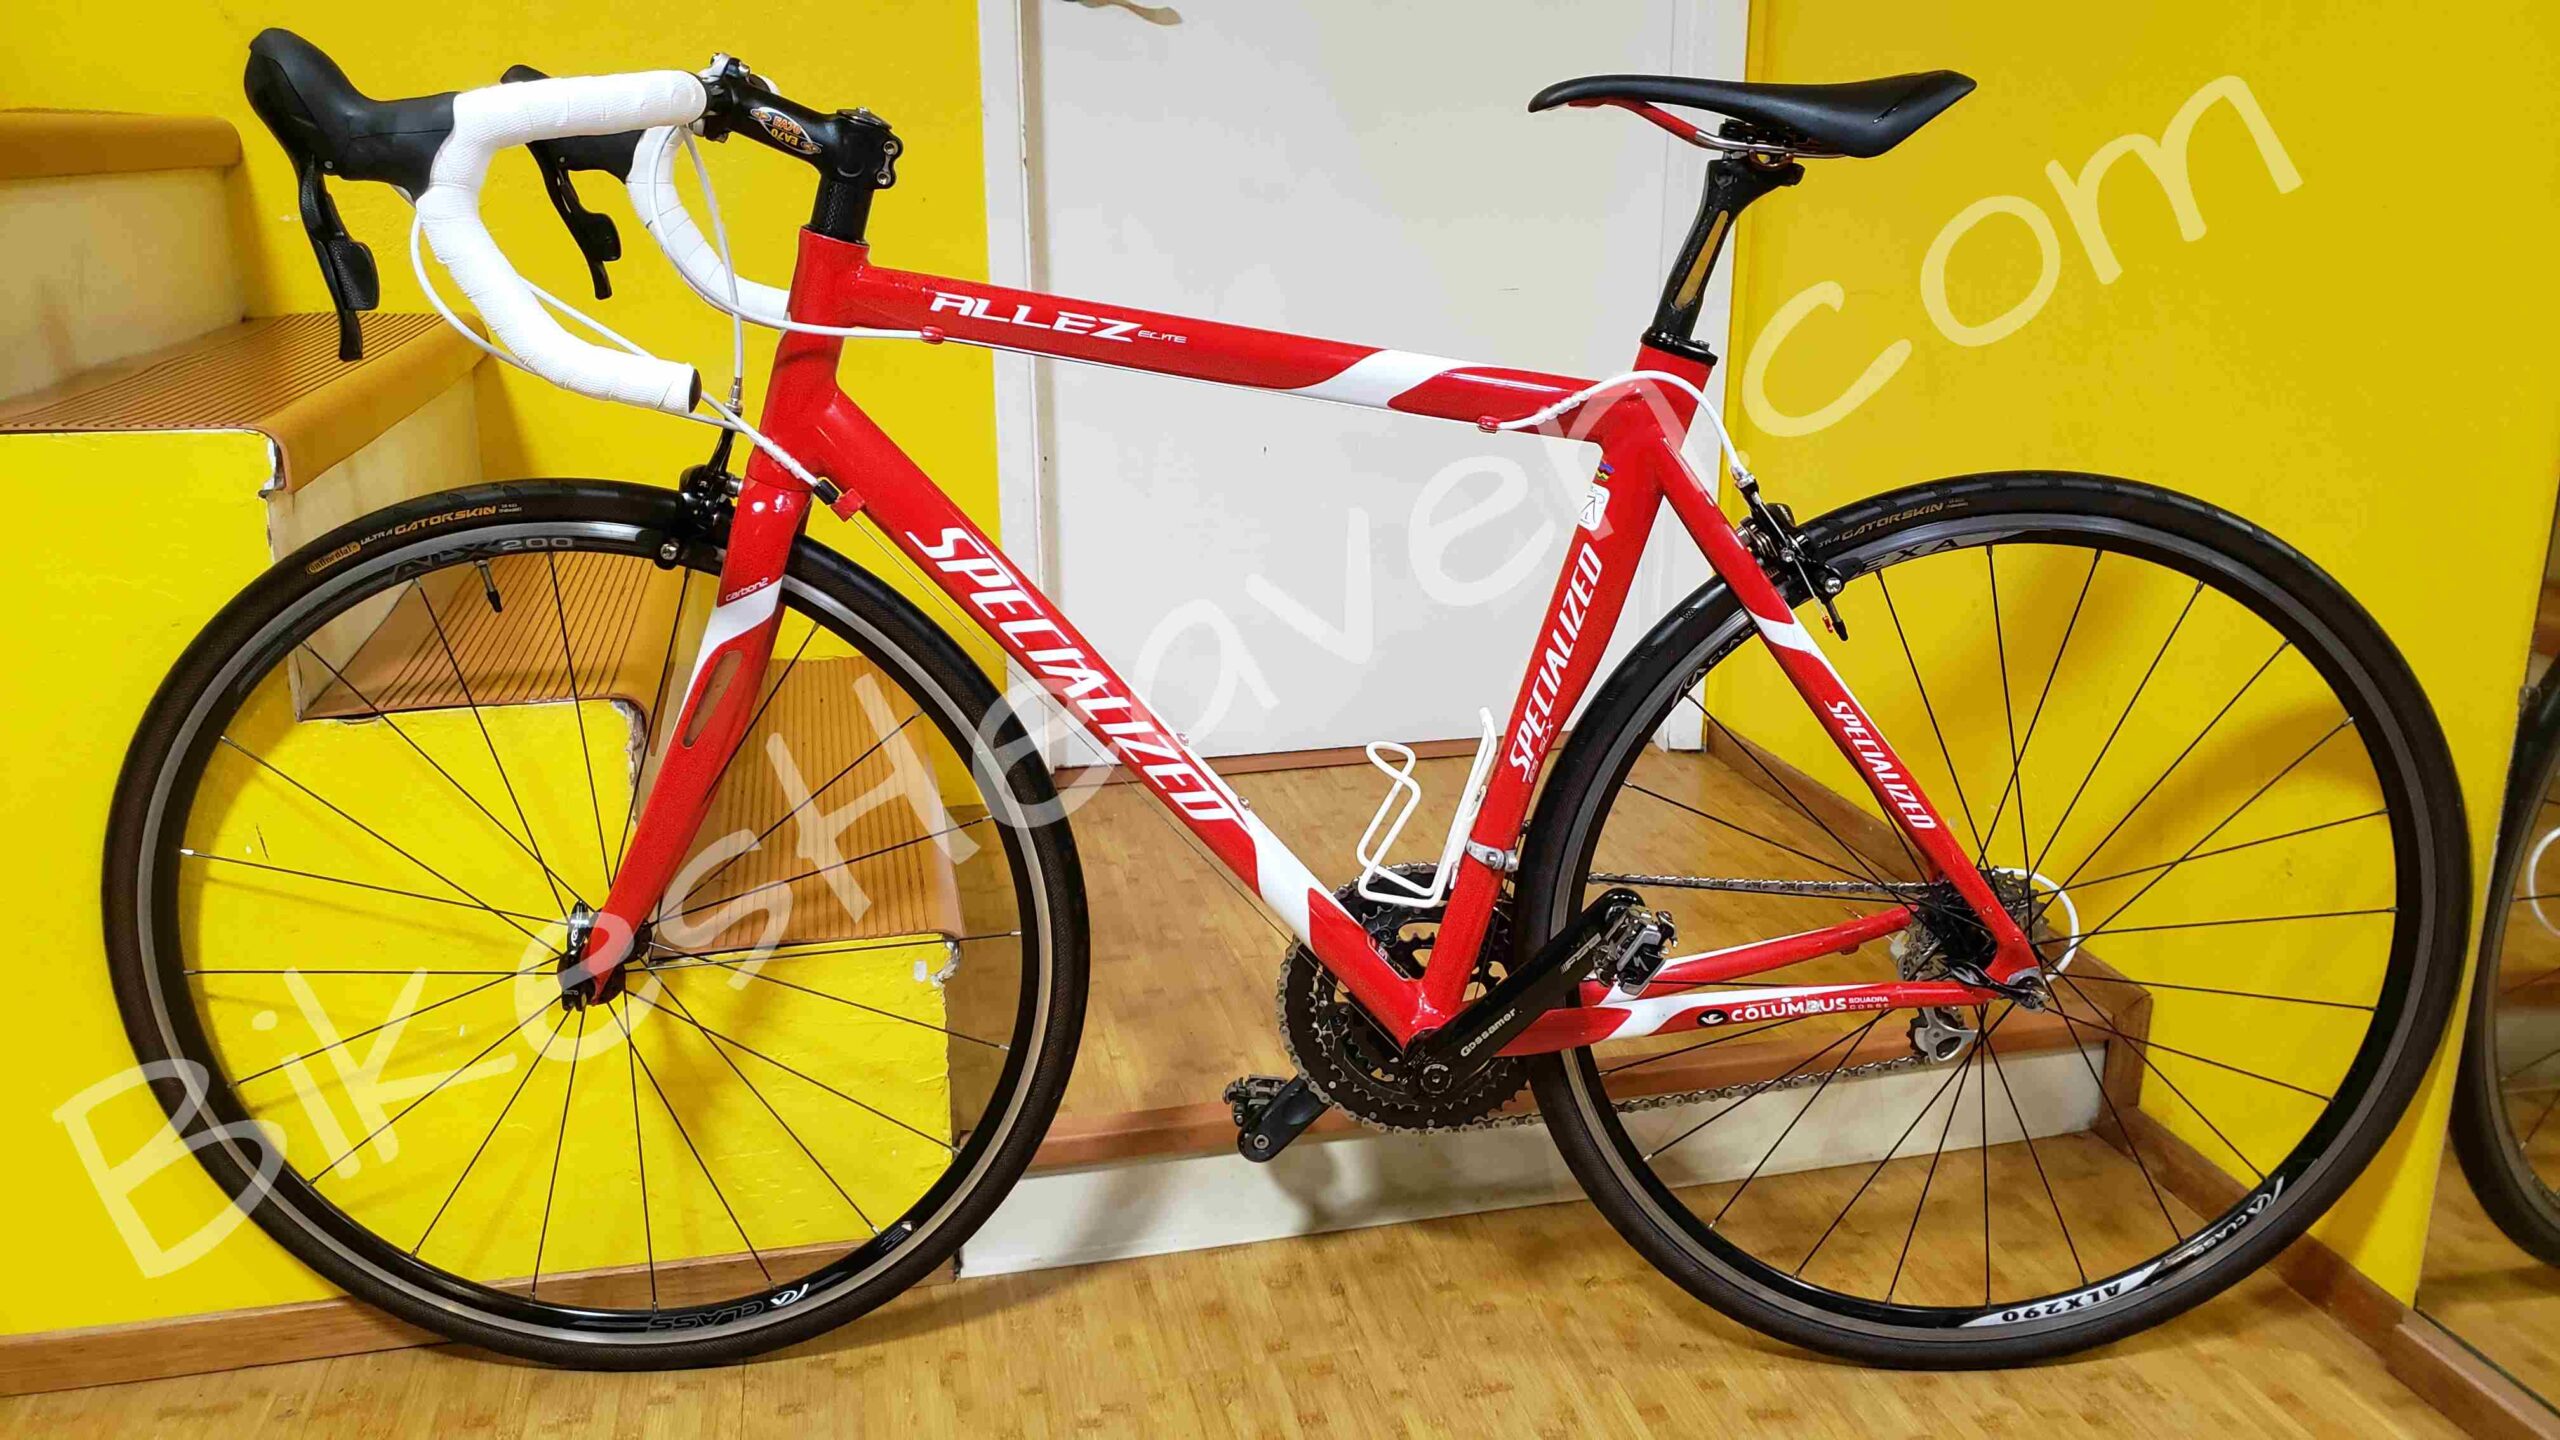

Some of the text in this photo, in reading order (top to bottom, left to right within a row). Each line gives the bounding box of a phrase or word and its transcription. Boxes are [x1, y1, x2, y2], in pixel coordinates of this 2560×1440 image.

[770, 128, 798, 146] EA70
[929, 291, 1143, 343] ALLEZ
[360, 529, 393, 546] ULTRA
[394, 505, 497, 536] GATORSKIN
[1842, 501, 1944, 541] GATORSKIN
[725, 576, 770, 602] carbon2
[905, 527, 1238, 820] SPECIALIZED
[1509, 542, 1603, 783] SPECIALIZED
[1823, 700, 1937, 829] SPECIALIZED
[2192, 1213, 2249, 1257] CLASS
[650, 1300, 765, 1331] CLASS
[2001, 1282, 2122, 1322] ALX290
